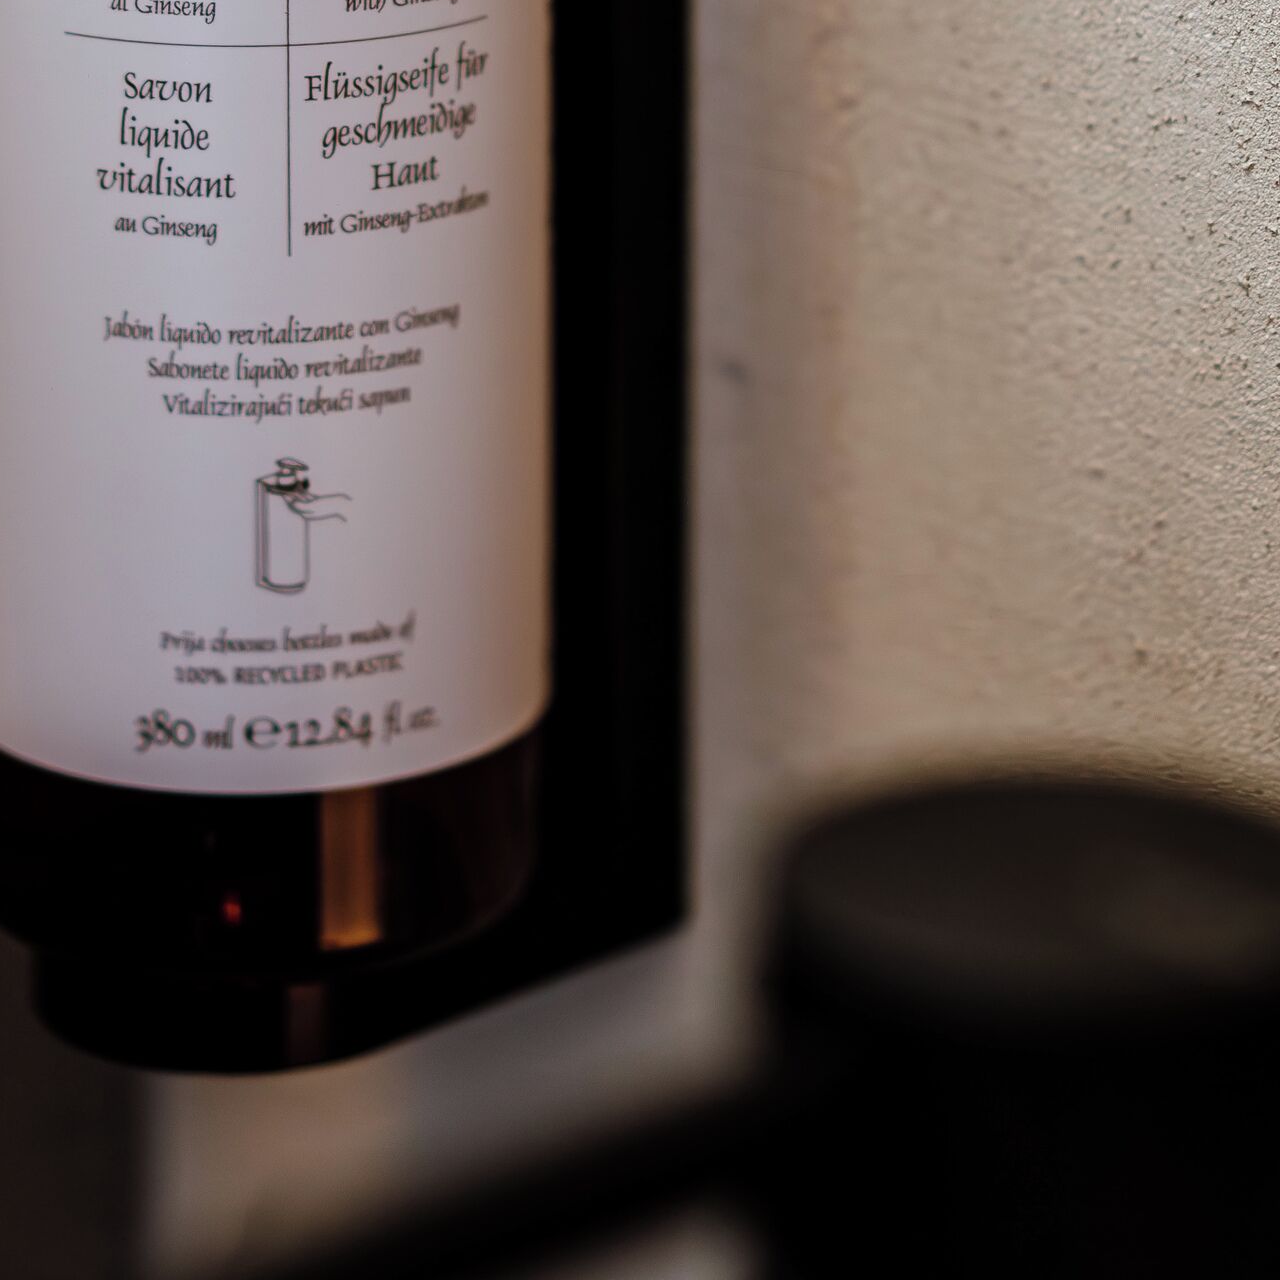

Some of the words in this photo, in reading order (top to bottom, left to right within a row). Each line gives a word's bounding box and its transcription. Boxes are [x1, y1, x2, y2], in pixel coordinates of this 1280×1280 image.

[122, 71, 214, 104] Savon
[304, 46, 449, 104] Flüssigseife
[455, 39, 489, 92] für
[119, 105, 211, 159] liquide
[322, 97, 476, 159] geschmeidige
[95, 156, 237, 200] vitalisant
[370, 155, 441, 192] Haut
[113, 216, 138, 234] au
[140, 215, 218, 247] Ginseng
[303, 213, 336, 237] mit
[226, 314, 355, 346] revitalizante
[358, 318, 391, 339] con
[146, 349, 230, 382] Sabonete
[303, 344, 423, 379] revitalizante
[231, 662, 327, 686] RECYCLED
[134, 708, 197, 754] 380
[201, 714, 236, 751] ml
